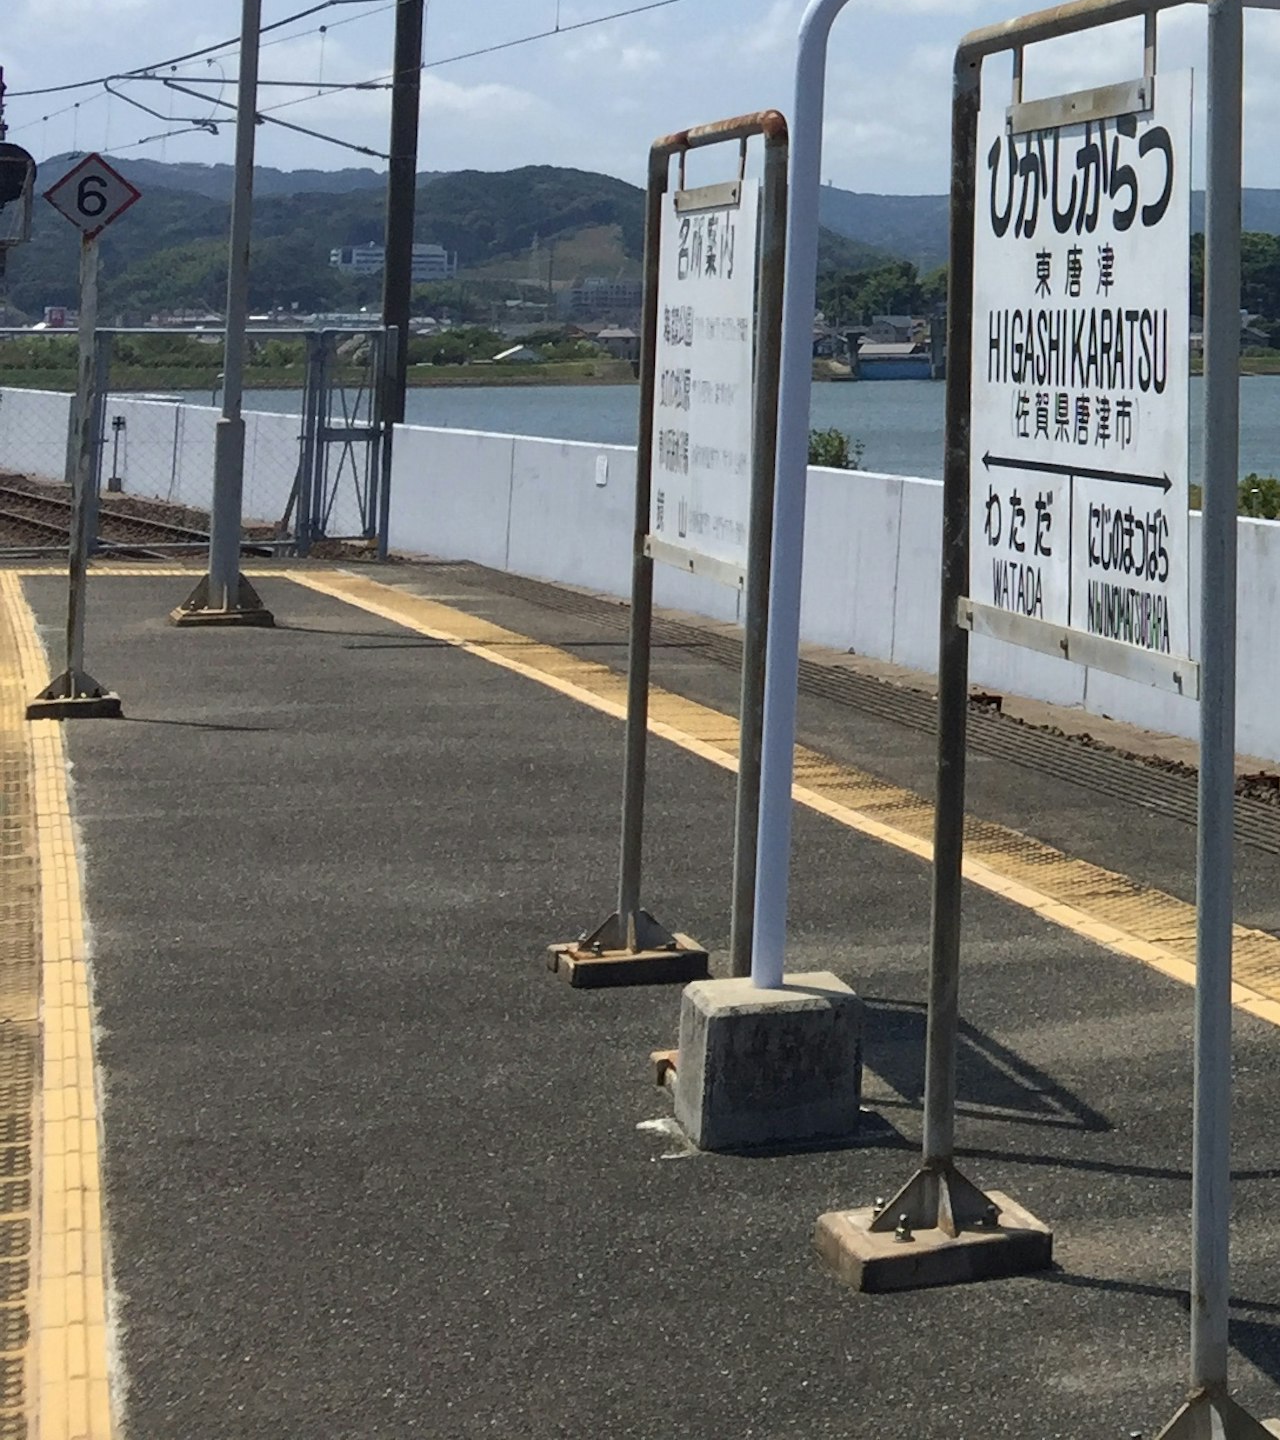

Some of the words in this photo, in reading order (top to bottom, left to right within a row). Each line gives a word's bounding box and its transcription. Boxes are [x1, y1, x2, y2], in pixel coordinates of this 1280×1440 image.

[77, 175, 107, 216] 6
[1035, 242, 1115, 299] 東唐津
[984, 484, 1053, 557] わただ
[1087, 502, 1169, 582] にじのまつばら
[993, 558, 1043, 620] WATADA
